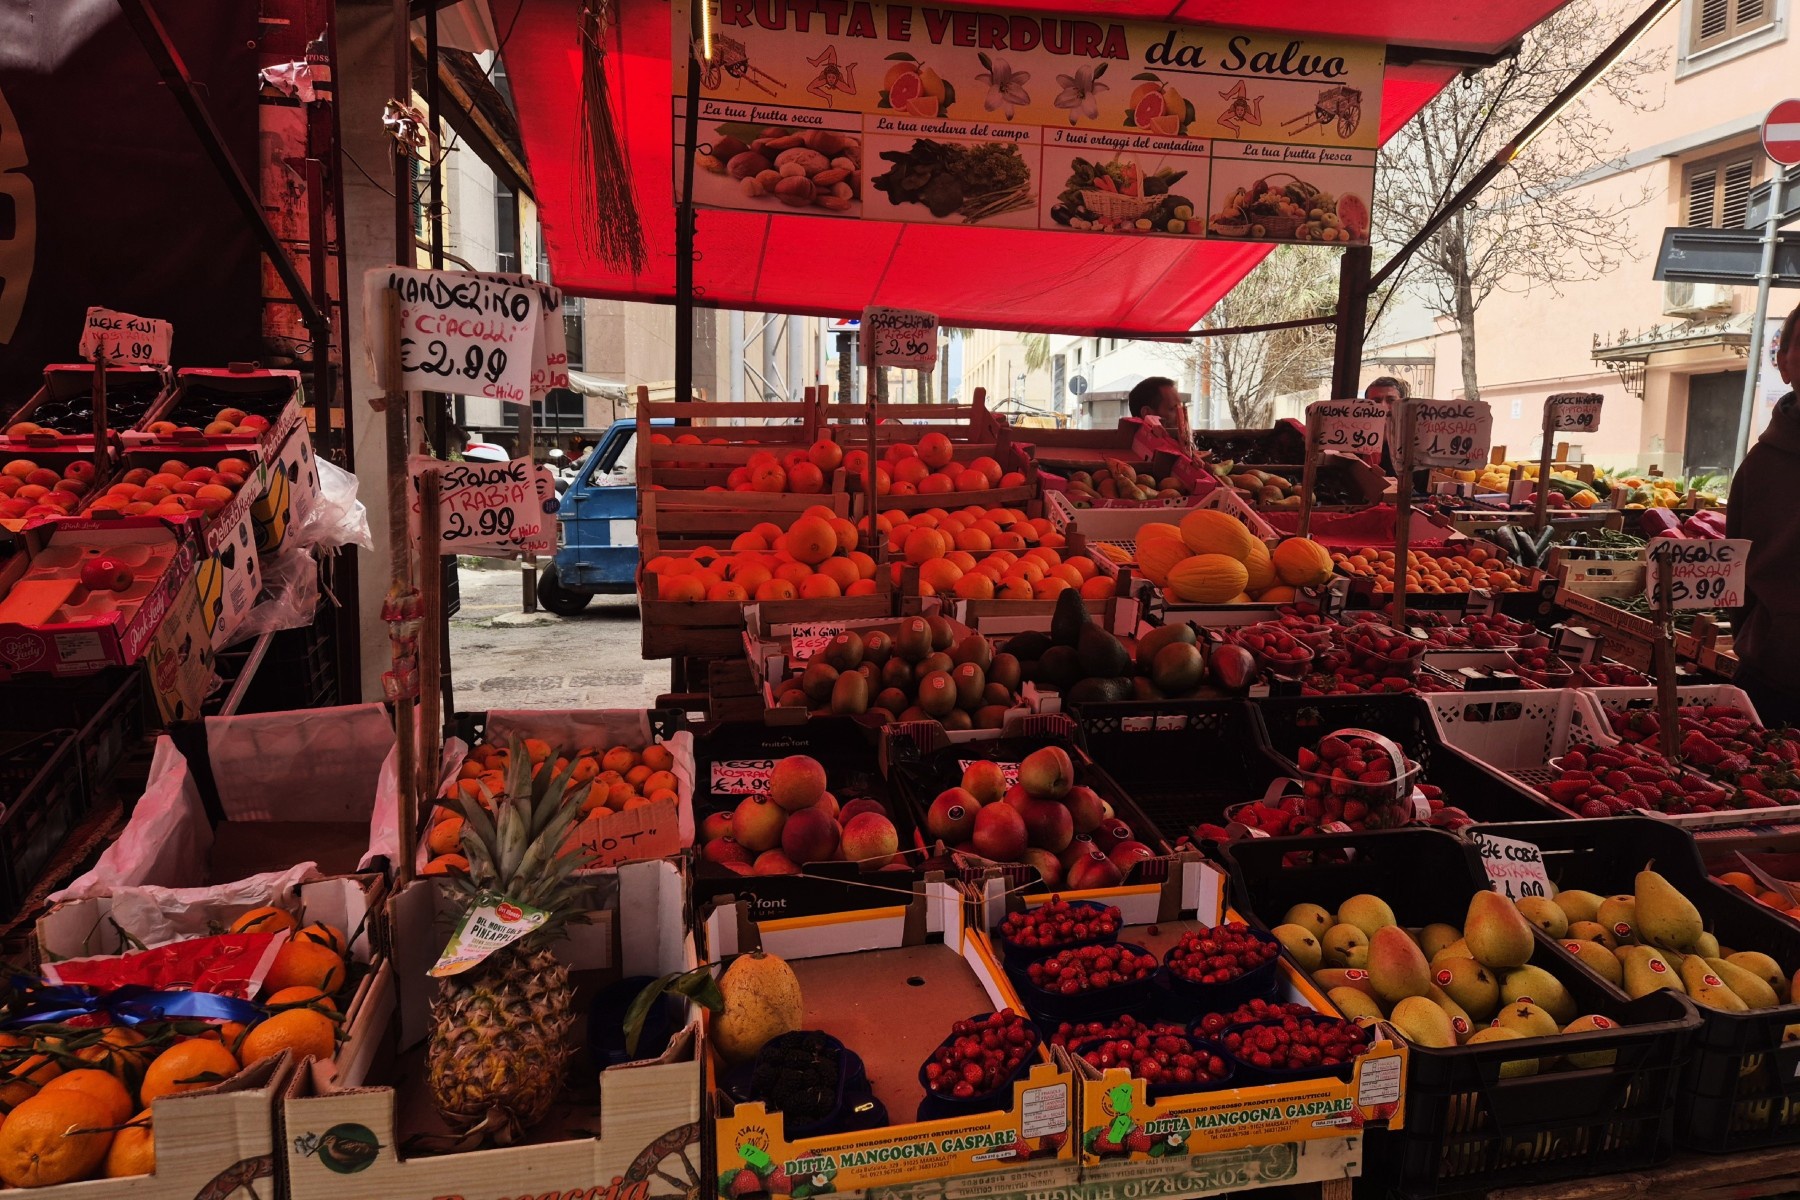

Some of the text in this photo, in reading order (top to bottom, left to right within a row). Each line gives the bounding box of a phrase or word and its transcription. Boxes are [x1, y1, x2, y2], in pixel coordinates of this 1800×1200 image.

[887, 4, 913, 42] E
[922, 7, 1129, 60] VERDURA
[1145, 30, 1348, 78] da Salvo
[702, 103, 823, 124] La tua frutta secca
[877, 117, 1030, 140] La tua verdura del campo
[1065, 132, 1088, 144] tuoi
[1091, 134, 1130, 149] ortaggi
[1133, 136, 1151, 149] del
[1153, 137, 1205, 153] contadino
[1243, 144, 1353, 162] La tua frutta fresca
[413, 461, 528, 492] SPOLONE
[130, 595, 165, 656] Pink Lady
[6, 637, 37, 653] Pink
[14, 645, 41, 662] Lady
[761, 738, 809, 749] fruites font
[719, 760, 775, 769] ESCA
[756, 898, 788, 909] font
[489, 921, 506, 933] MONTE
[1243, 1098, 1276, 1107] PRODOTTI
[1144, 1097, 1354, 1135] DITTA MANGOGNA GASPARE
[738, 1125, 765, 1136] ITALIA
[894, 1133, 930, 1143] PRODOTTI
[931, 1124, 991, 1138] ORTOFRUTTICOLI
[785, 1129, 1017, 1175] DITTA MANGOGNA GASPARE
[1123, 1168, 1248, 1198] CONSORZIO
